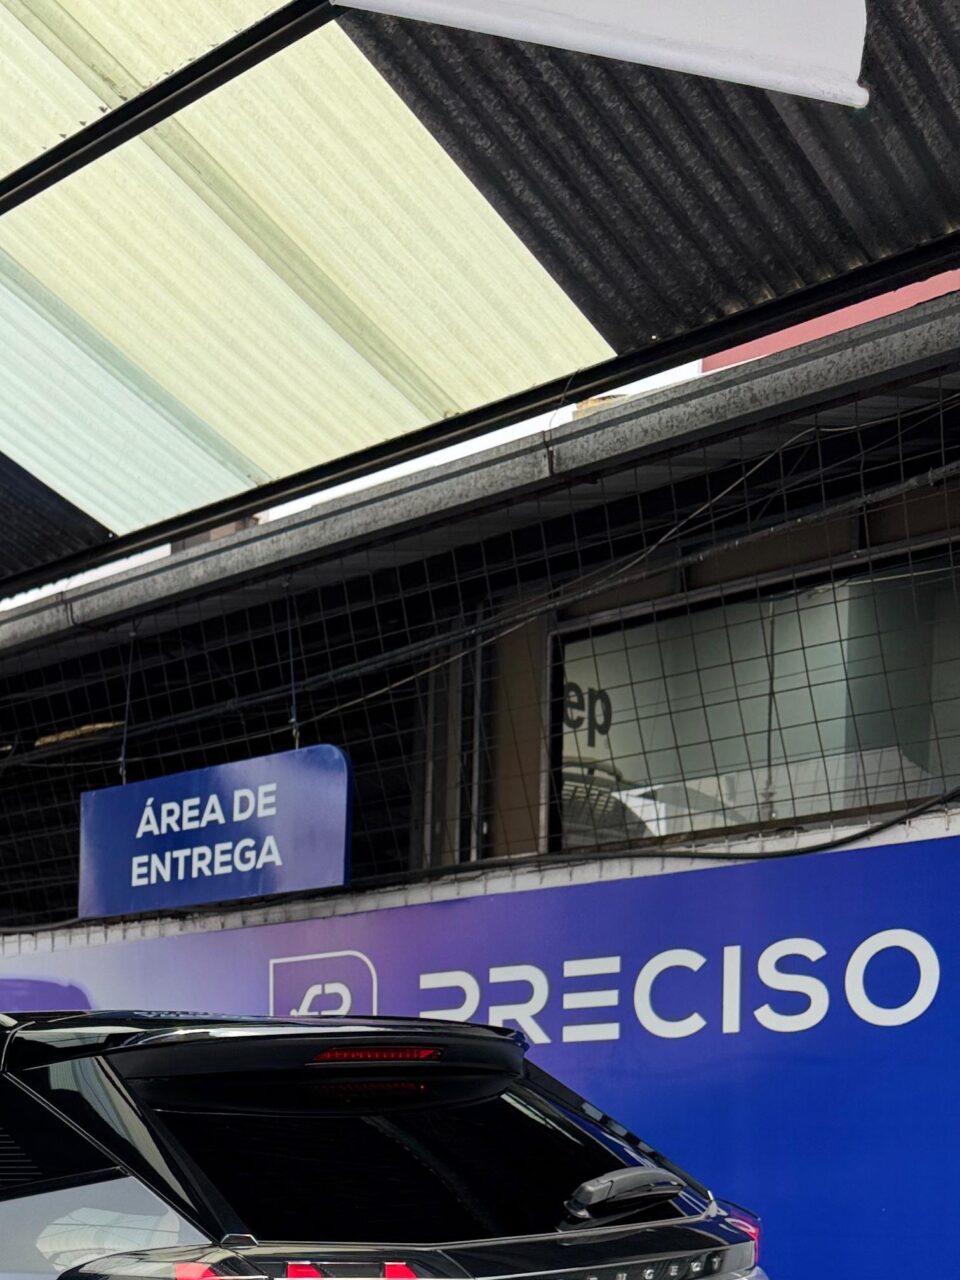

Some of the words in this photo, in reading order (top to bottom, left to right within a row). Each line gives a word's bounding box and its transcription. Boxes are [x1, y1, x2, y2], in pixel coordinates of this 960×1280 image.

[135, 793, 226, 839] ÁREA
[233, 782, 278, 823] DE
[131, 835, 283, 887] ENTREGA
[418, 928, 942, 1045] PRECISO
